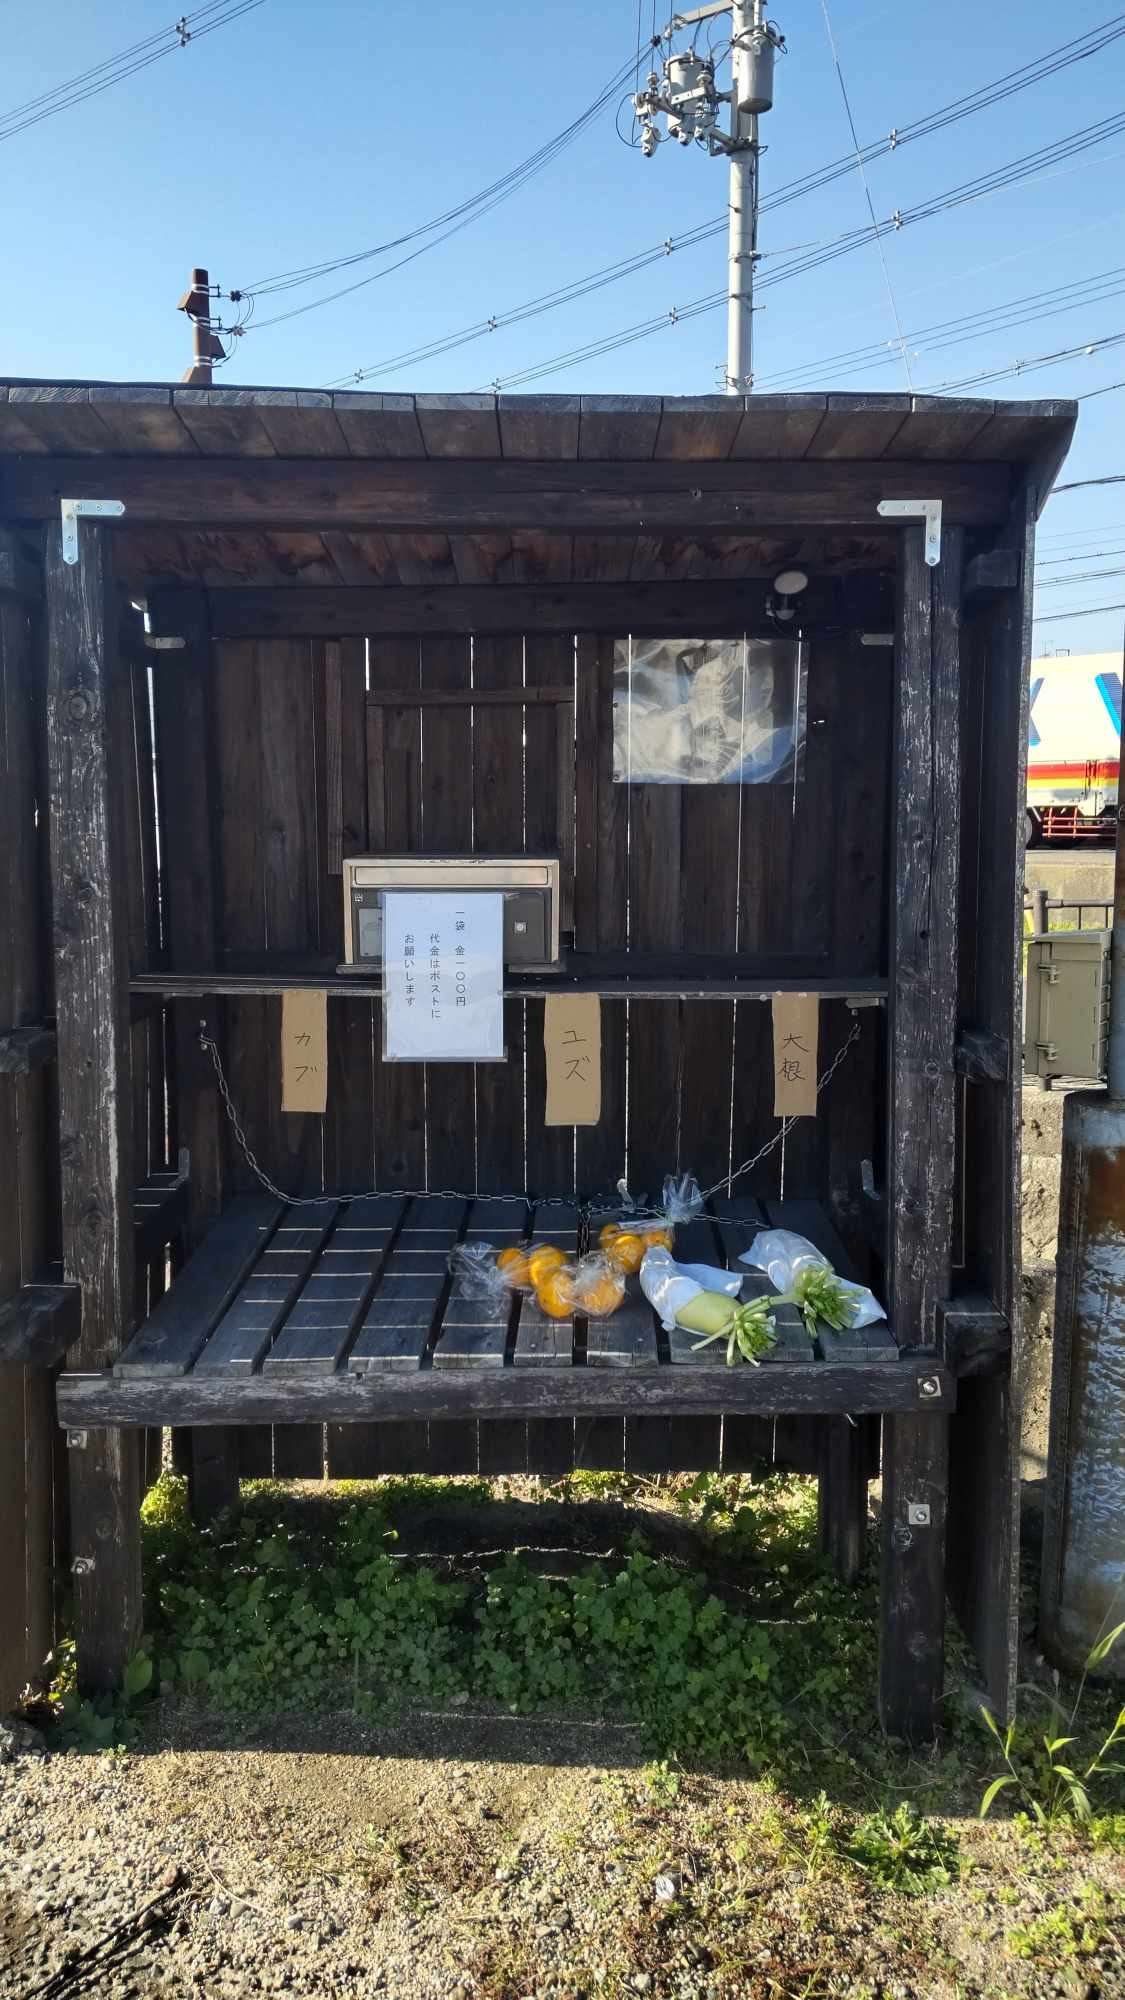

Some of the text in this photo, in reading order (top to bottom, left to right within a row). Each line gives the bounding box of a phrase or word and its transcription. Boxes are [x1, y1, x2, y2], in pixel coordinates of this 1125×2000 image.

[455, 911, 465, 931] 一袋
[404, 934, 415, 1007] お願いします
[430, 933, 441, 1019] 代金はポストに
[294, 1032, 318, 1082] カブ
[561, 1030, 592, 1082] ユズ
[777, 1033, 809, 1082] 大根
